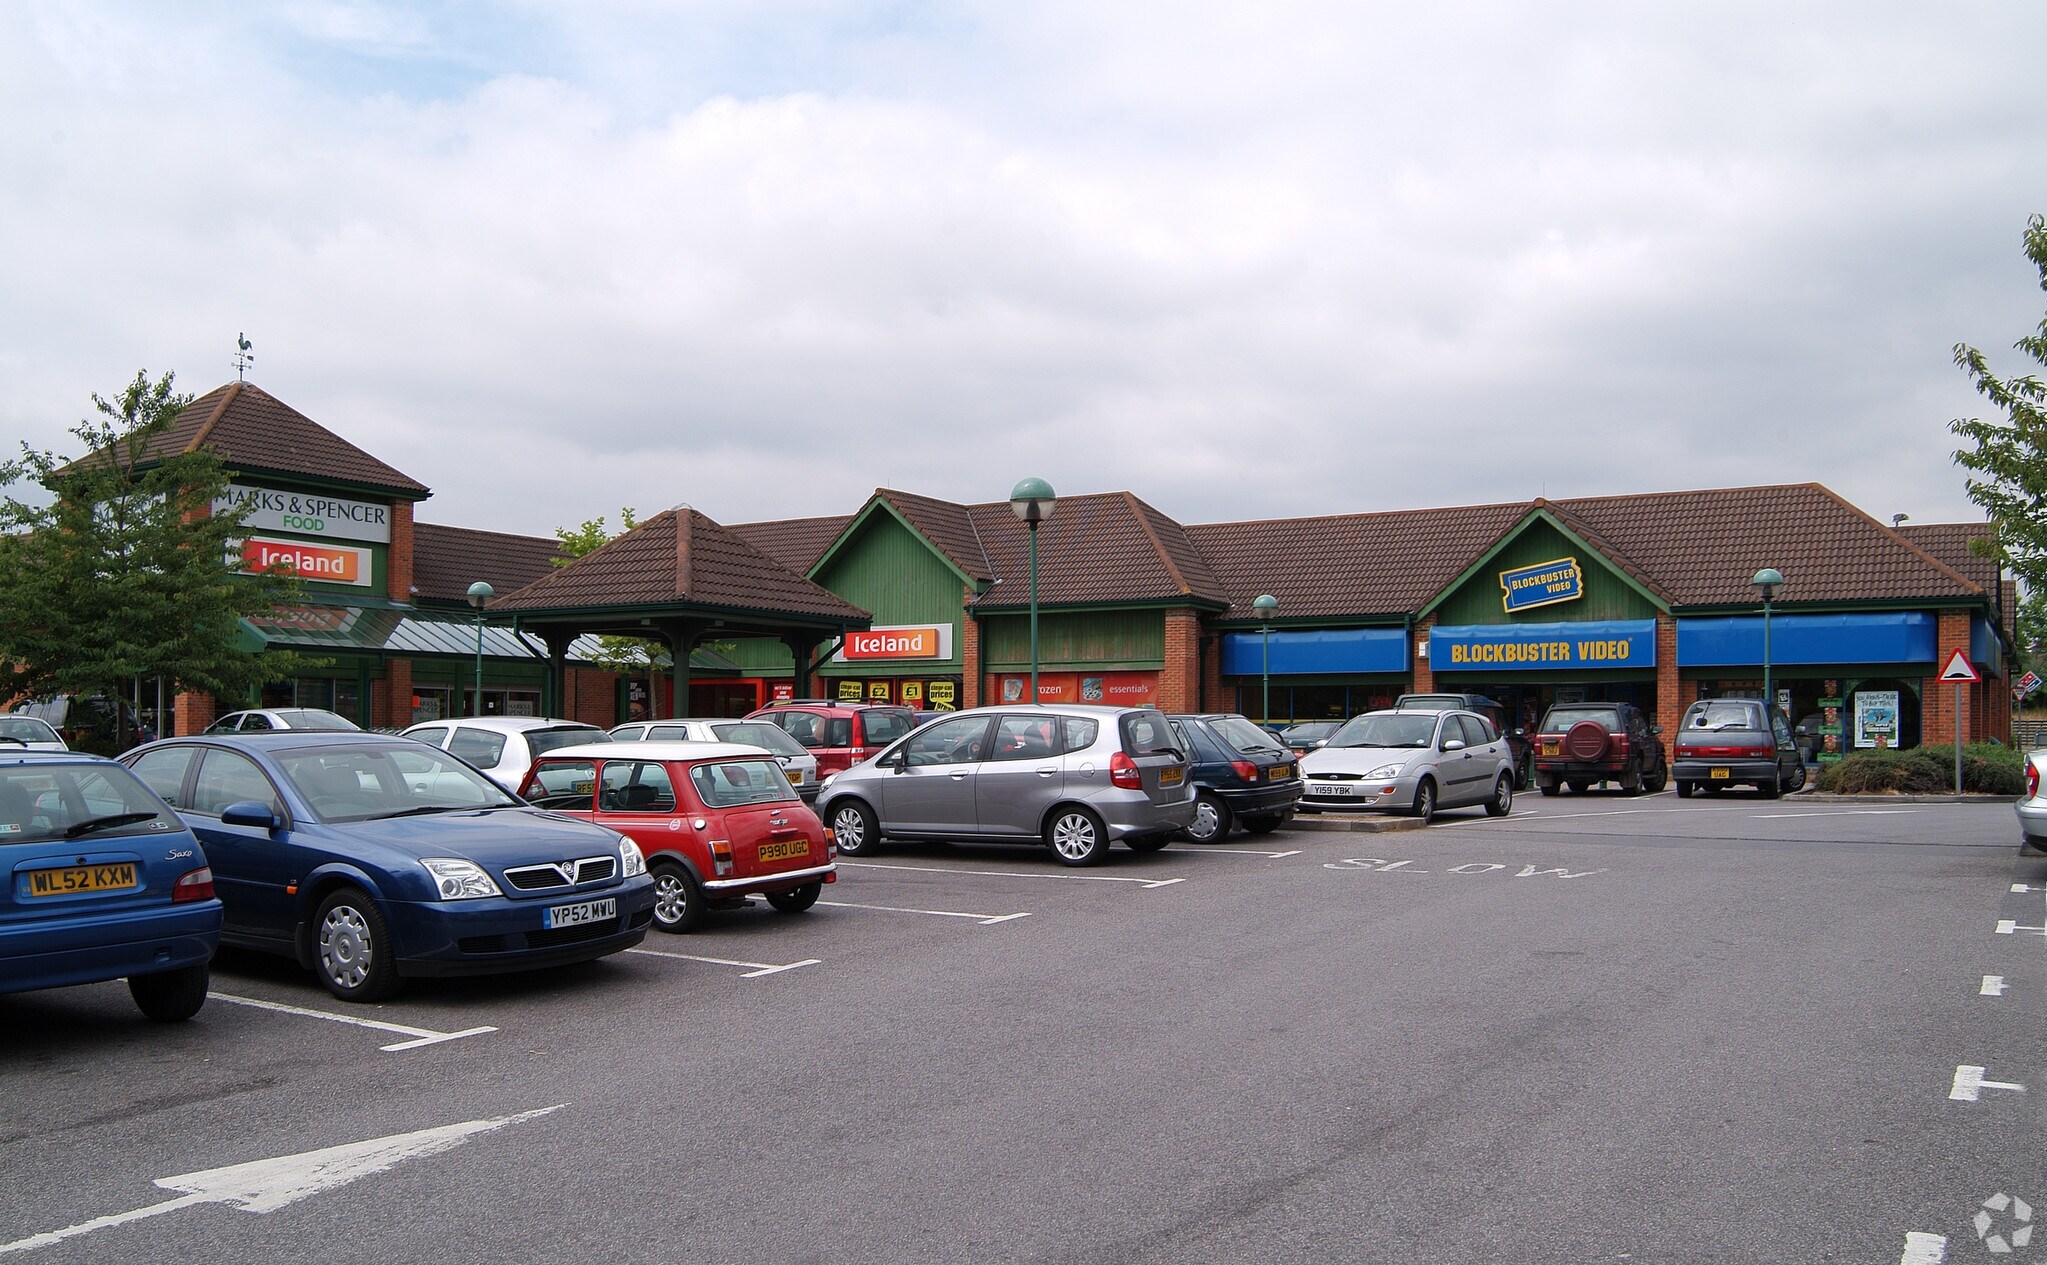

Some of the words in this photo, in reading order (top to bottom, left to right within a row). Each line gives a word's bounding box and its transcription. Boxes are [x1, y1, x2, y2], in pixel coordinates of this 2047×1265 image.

[215, 486, 285, 512] MARKS
[288, 496, 302, 514] &
[305, 498, 386, 524] SPENCER
[283, 514, 325, 532] FOOD
[262, 547, 344, 574] Iceland
[1511, 568, 1575, 590] BLOCKBUSTER
[1546, 581, 1571, 593] VIDEO
[854, 633, 922, 653] Iceland
[1451, 641, 1570, 663] BLOCKBUSTER
[1577, 640, 1630, 661] VIDEO
[840, 689, 861, 698] prices
[872, 687, 886, 697] £2
[906, 686, 918, 696] £1
[930, 690, 953, 699] prices
[1037, 685, 1062, 694] rozen
[1109, 684, 1149, 693] essentials
[1314, 786, 1333, 795] Y159
[1334, 786, 1351, 795] YBK
[164, 849, 192, 861] Saxo
[760, 844, 787, 859] P990
[789, 841, 808, 854] UGC
[1323, 858, 1608, 878] SLOW
[34, 870, 90, 892] WL52
[95, 866, 134, 887] KXM
[551, 904, 589, 925] YP52
[592, 900, 615, 918] MWU
